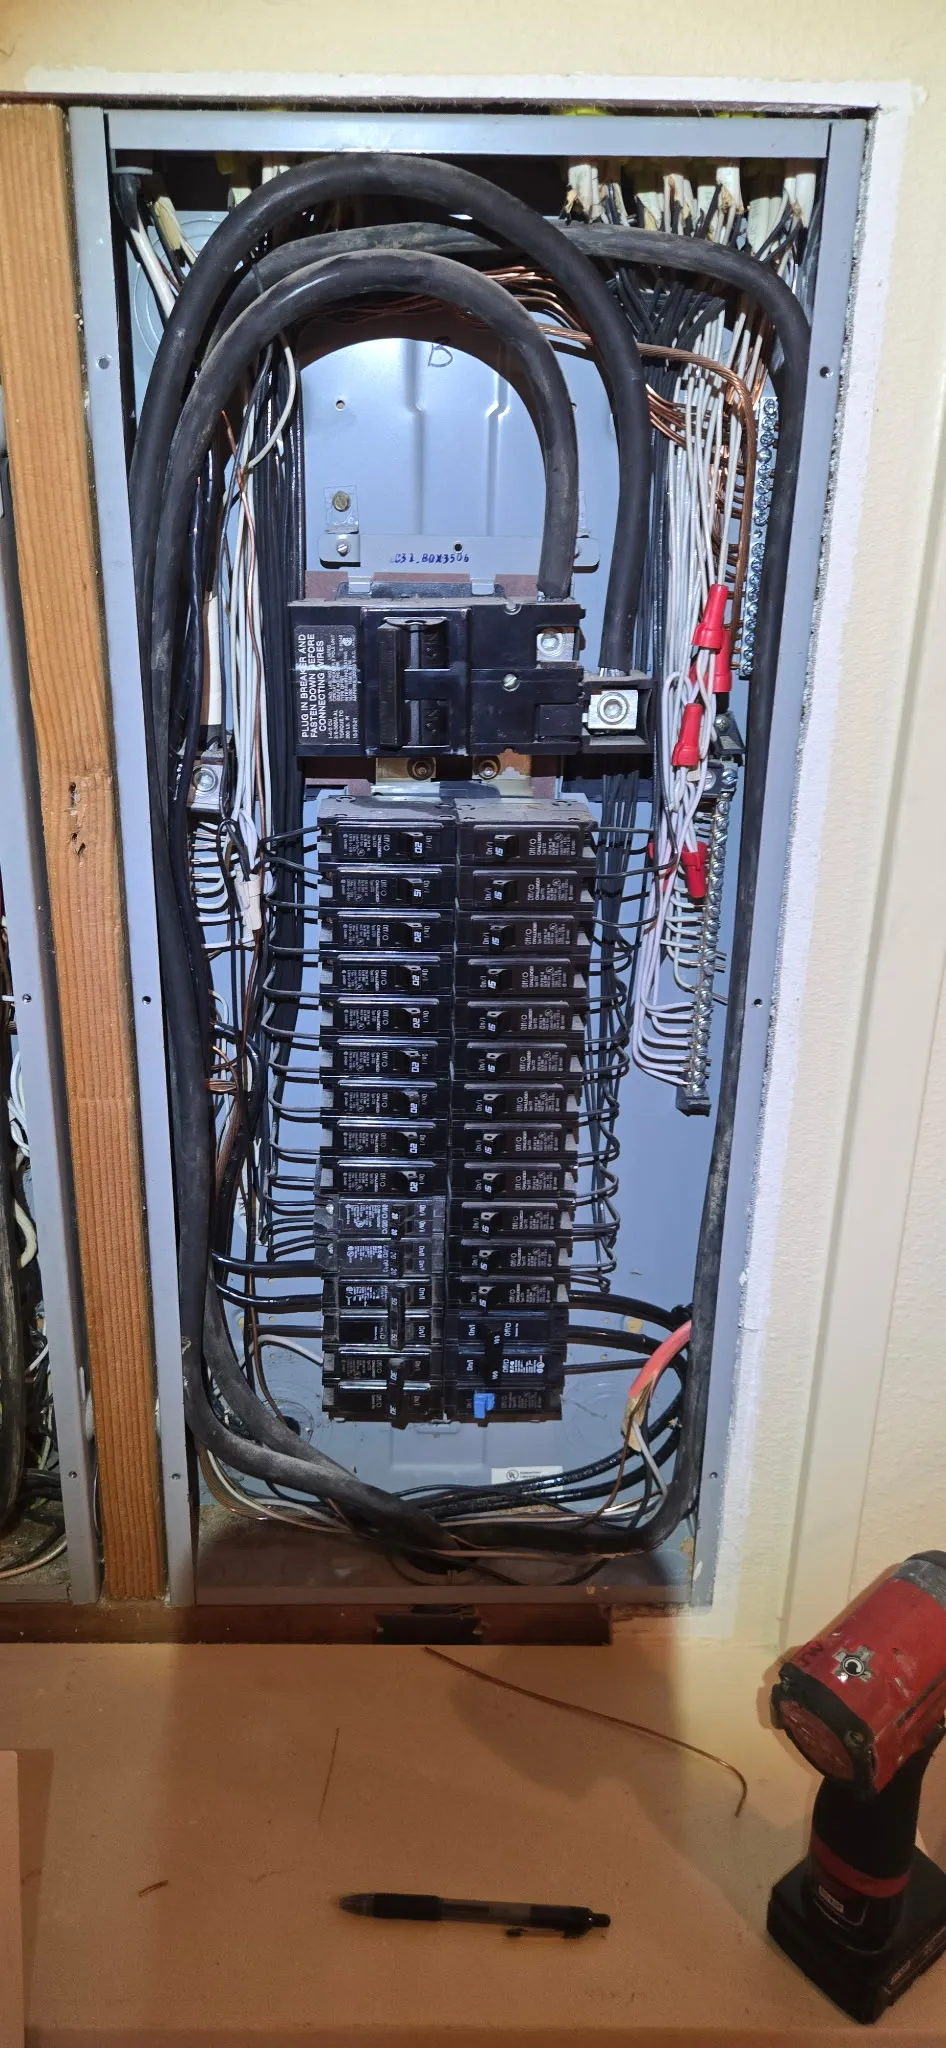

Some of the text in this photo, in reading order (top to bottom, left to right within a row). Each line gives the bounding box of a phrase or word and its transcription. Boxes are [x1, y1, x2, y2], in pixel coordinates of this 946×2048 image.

[307, 634, 315, 670] BEFORE
[299, 657, 307, 698] BREAKER
[316, 641, 326, 731] CONNECTING WIRES
[301, 702, 308, 710] IN
[301, 714, 309, 737] PLUG
[415, 842, 422, 853] 20
[496, 847, 503, 856] 15
[414, 889, 421, 897] 15
[494, 891, 502, 900] 15
[414, 932, 421, 942] 20
[492, 937, 499, 945] 15
[412, 975, 419, 986] 20
[488, 980, 496, 989] 15
[413, 1018, 420, 1028] 20
[411, 1062, 419, 1072] 20
[410, 1103, 417, 1113] 20
[485, 1105, 492, 1113] 15
[410, 1143, 417, 1153] 20
[410, 1182, 418, 1192] 20
[391, 1370, 397, 1380] 30
[390, 1405, 396, 1415] 30
